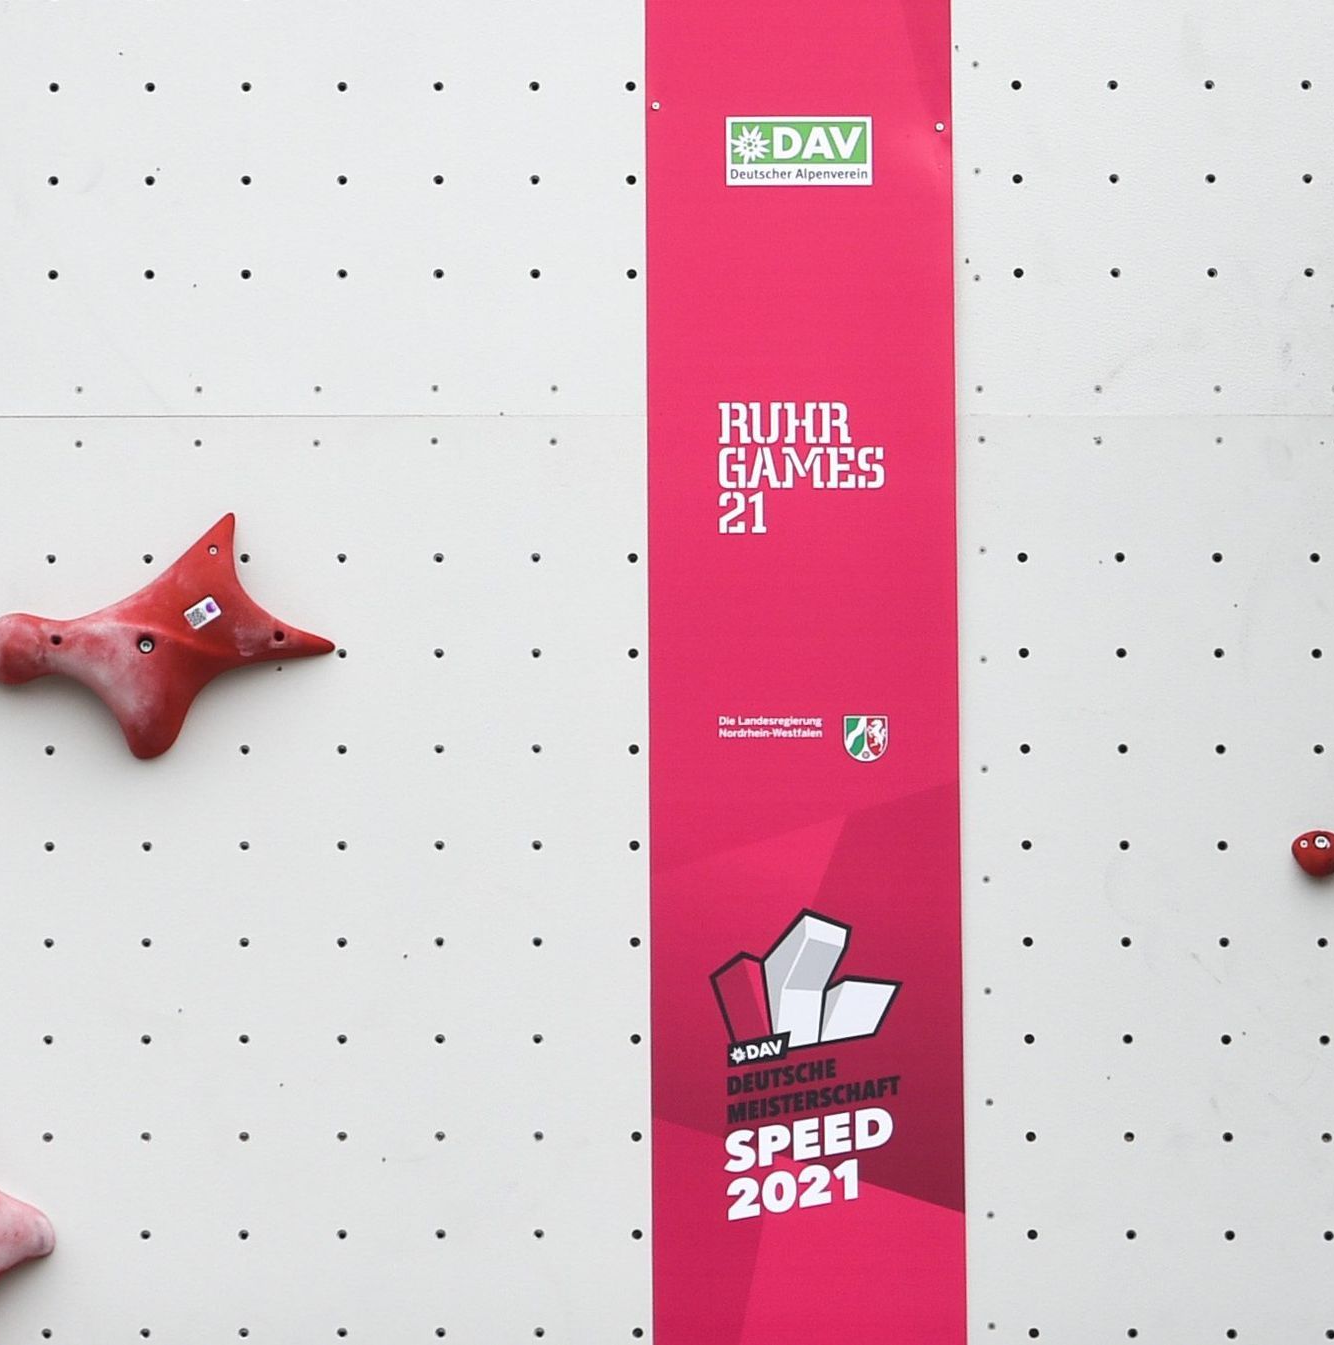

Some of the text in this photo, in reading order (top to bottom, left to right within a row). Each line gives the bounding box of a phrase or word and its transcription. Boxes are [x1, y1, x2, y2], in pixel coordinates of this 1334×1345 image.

[772, 126, 863, 160] DAV
[730, 168, 868, 182] Deutscher Alpenverein
[718, 401, 852, 444] RUHR
[718, 446, 885, 489] GAMES
[718, 490, 767, 534] 21
[718, 716, 823, 728] Die Landesregierung
[718, 728, 823, 738] Nordrhein-Westfalen
[745, 1039, 782, 1061] DAV
[727, 1058, 837, 1096] DEUTSCHE
[727, 1075, 901, 1124] MEISTERSCHAFT
[724, 1107, 894, 1173] SPEED
[726, 1158, 858, 1221] 2021
